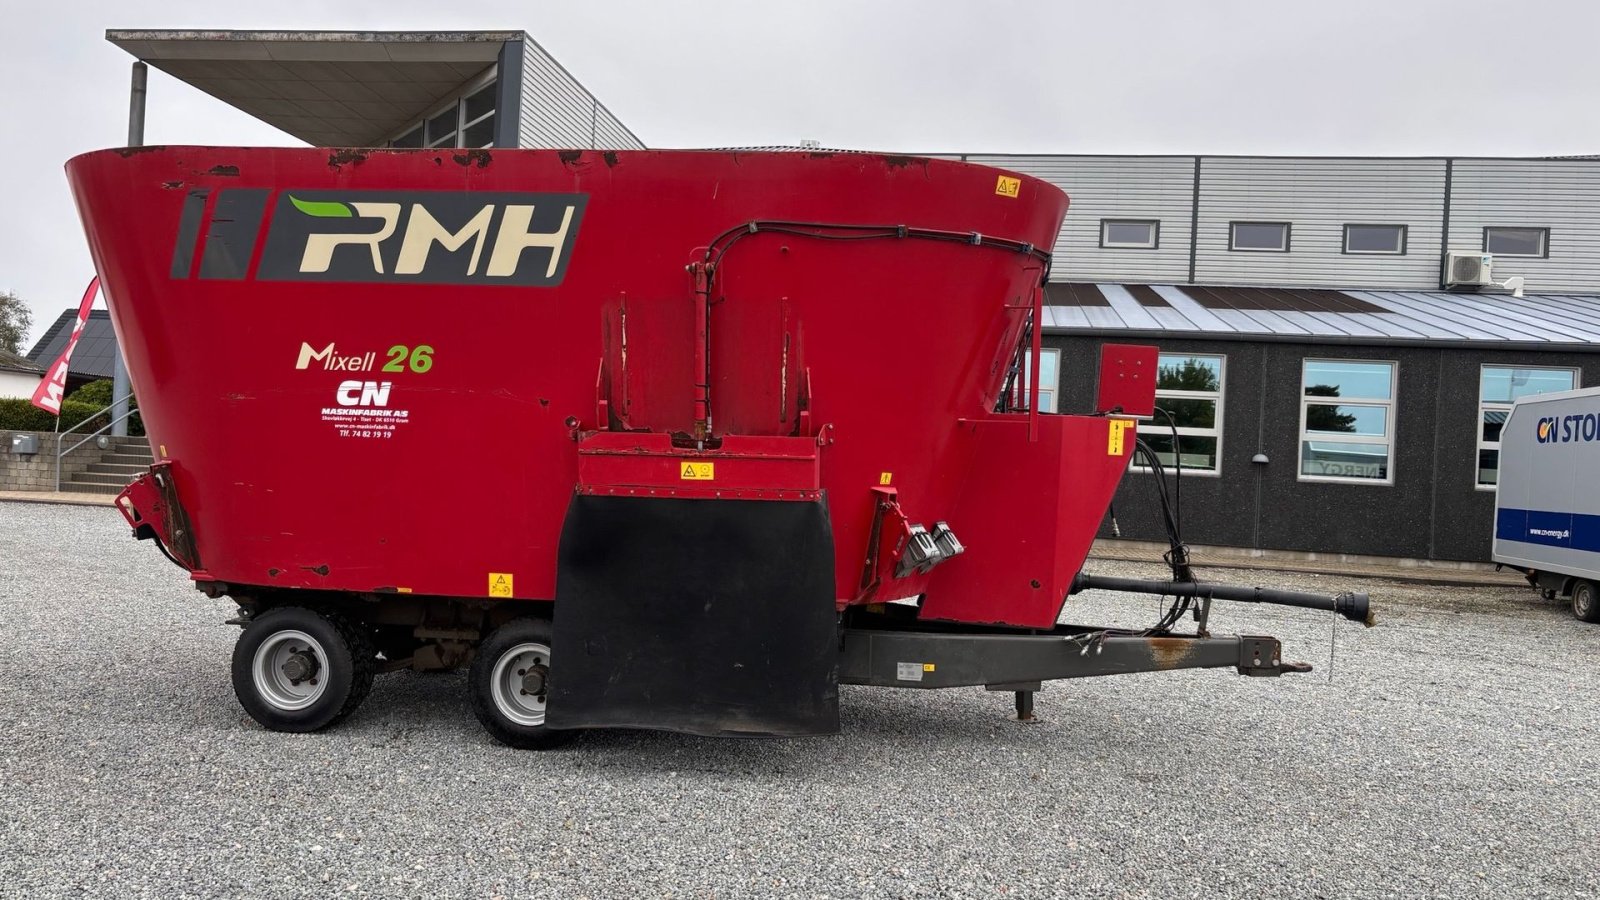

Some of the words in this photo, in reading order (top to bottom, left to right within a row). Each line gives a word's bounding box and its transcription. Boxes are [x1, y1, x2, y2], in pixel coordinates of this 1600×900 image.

[290, 194, 575, 278] RMH
[295, 341, 376, 372] Mixell
[381, 344, 434, 374] 26
[336, 380, 392, 407] CN
[321, 408, 392, 417] MASKINFABRIK
[362, 430, 371, 438] 82
[372, 431, 382, 439] 19
[383, 431, 392, 439] 19
[1537, 416, 1559, 443] CN
